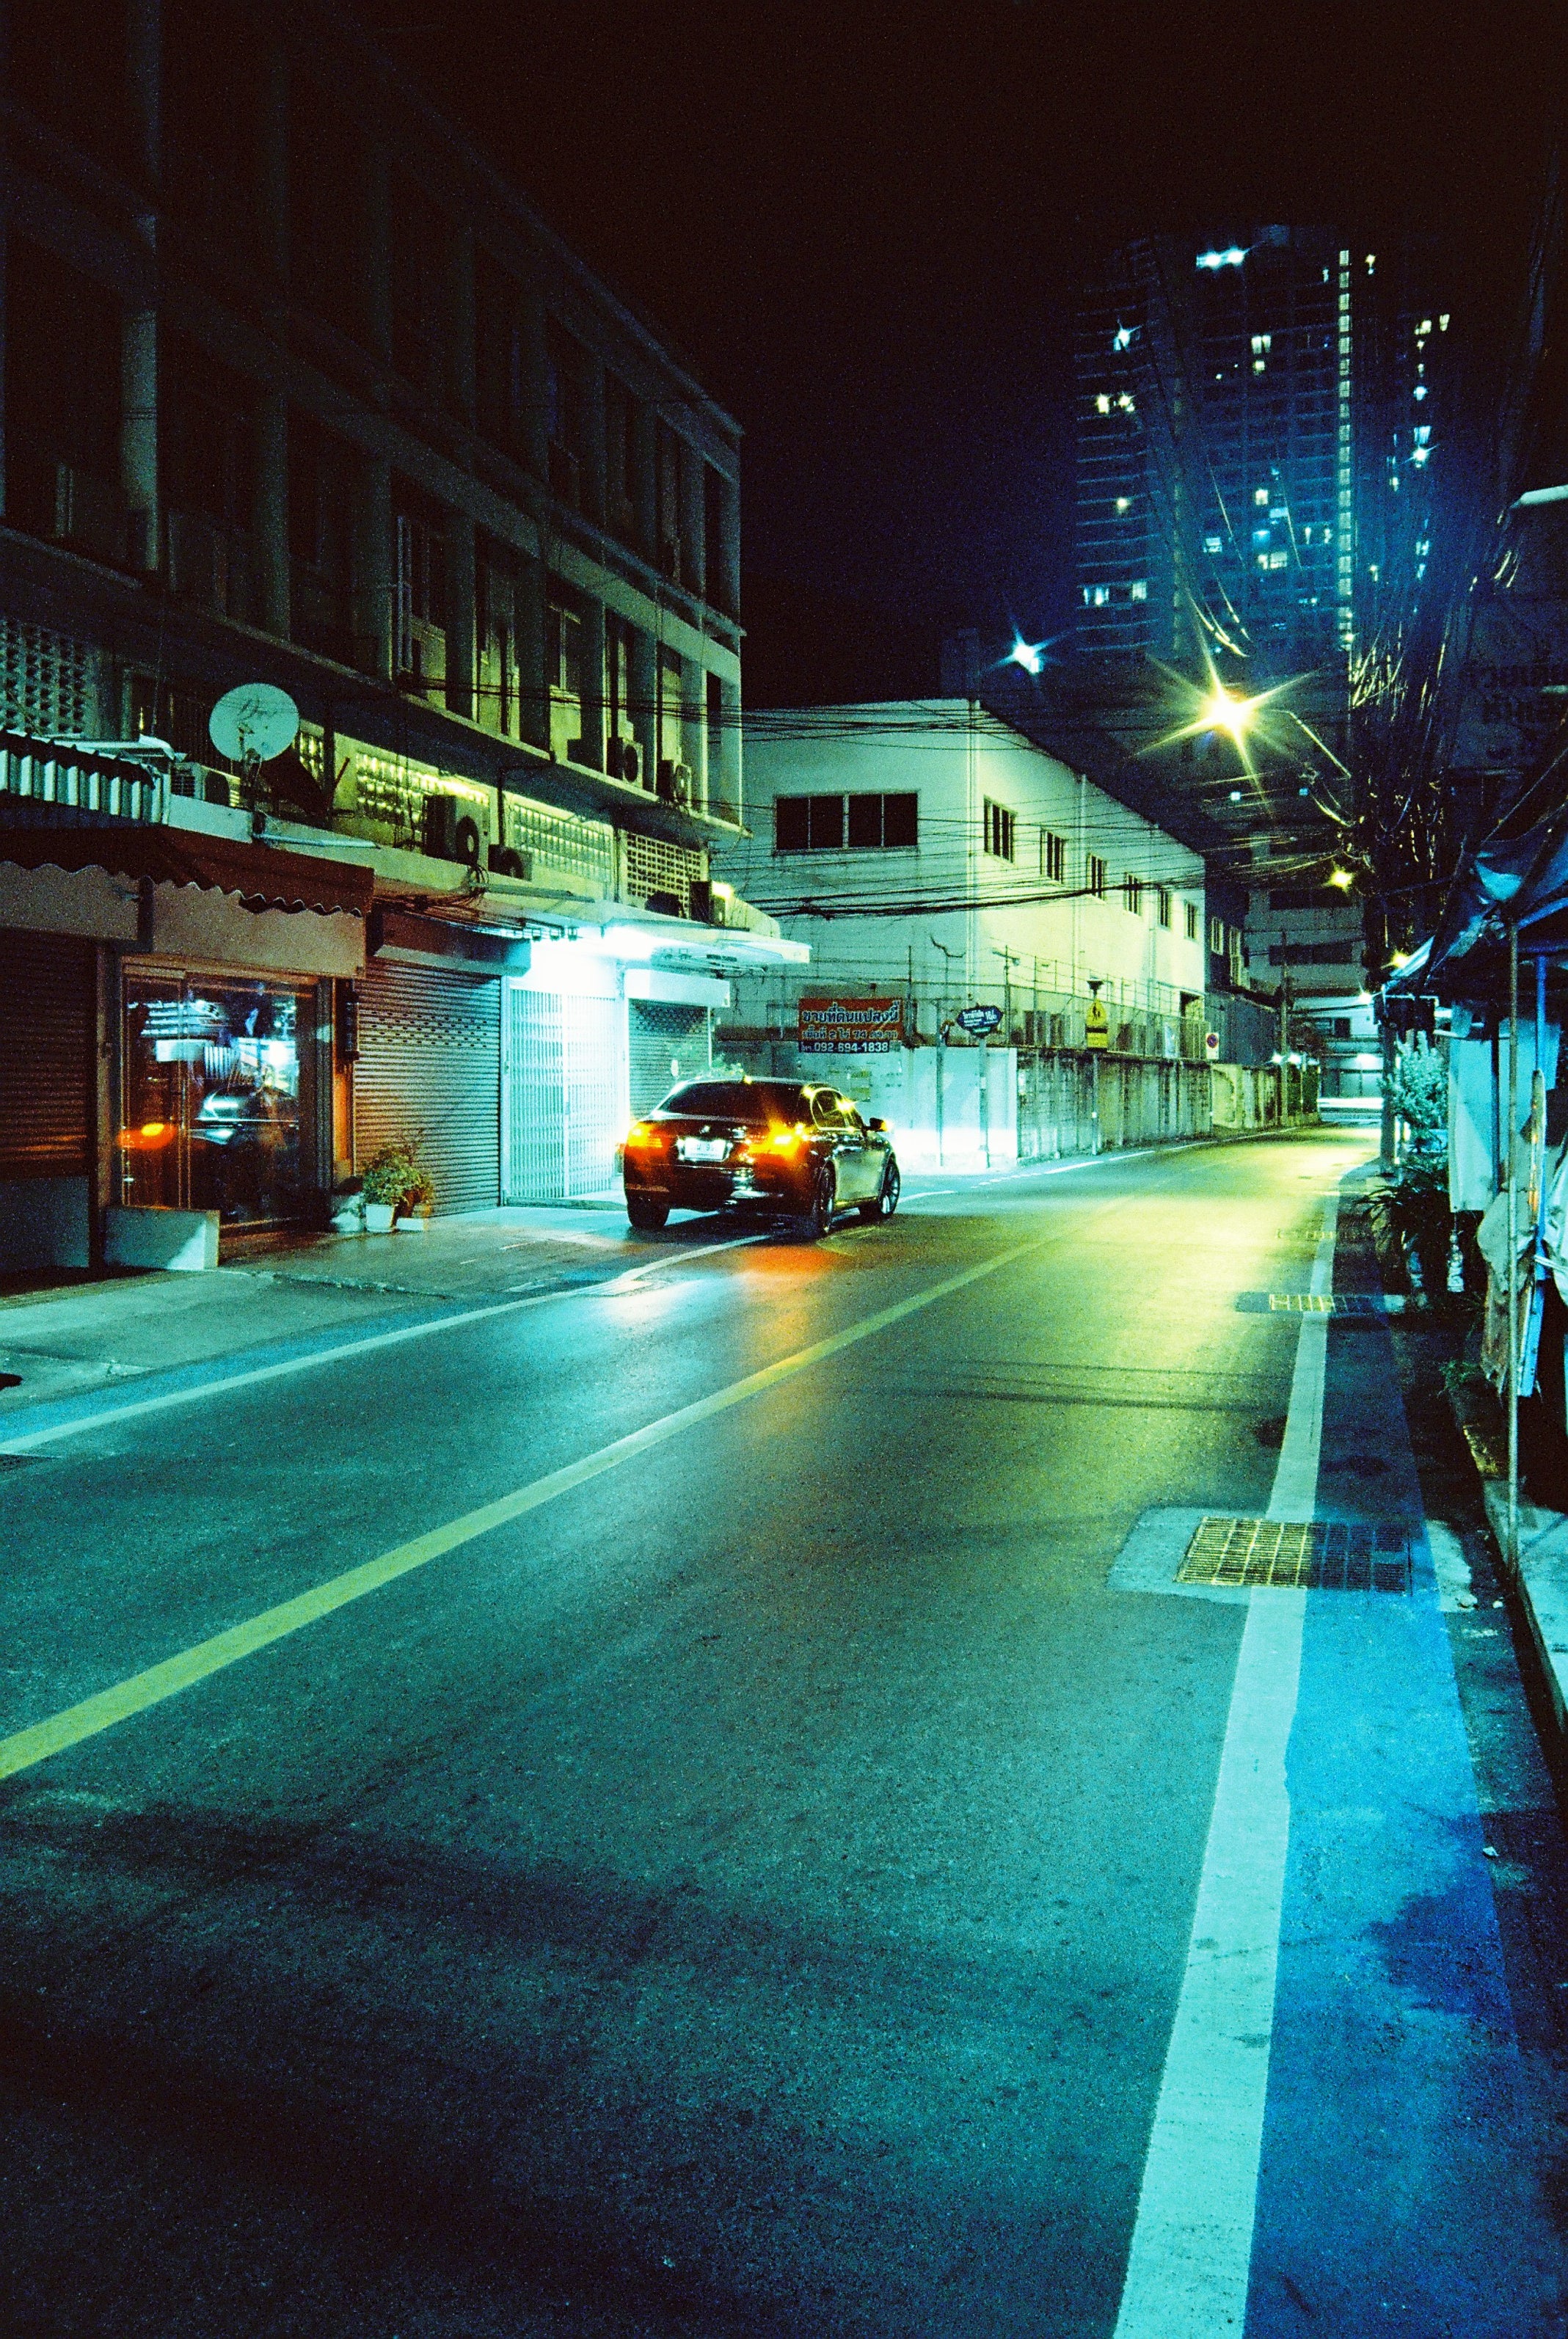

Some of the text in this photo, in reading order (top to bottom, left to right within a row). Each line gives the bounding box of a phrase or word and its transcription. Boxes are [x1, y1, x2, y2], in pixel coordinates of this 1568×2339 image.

[802, 1000, 900, 1023] ขายที่ดินแปลงนี้
